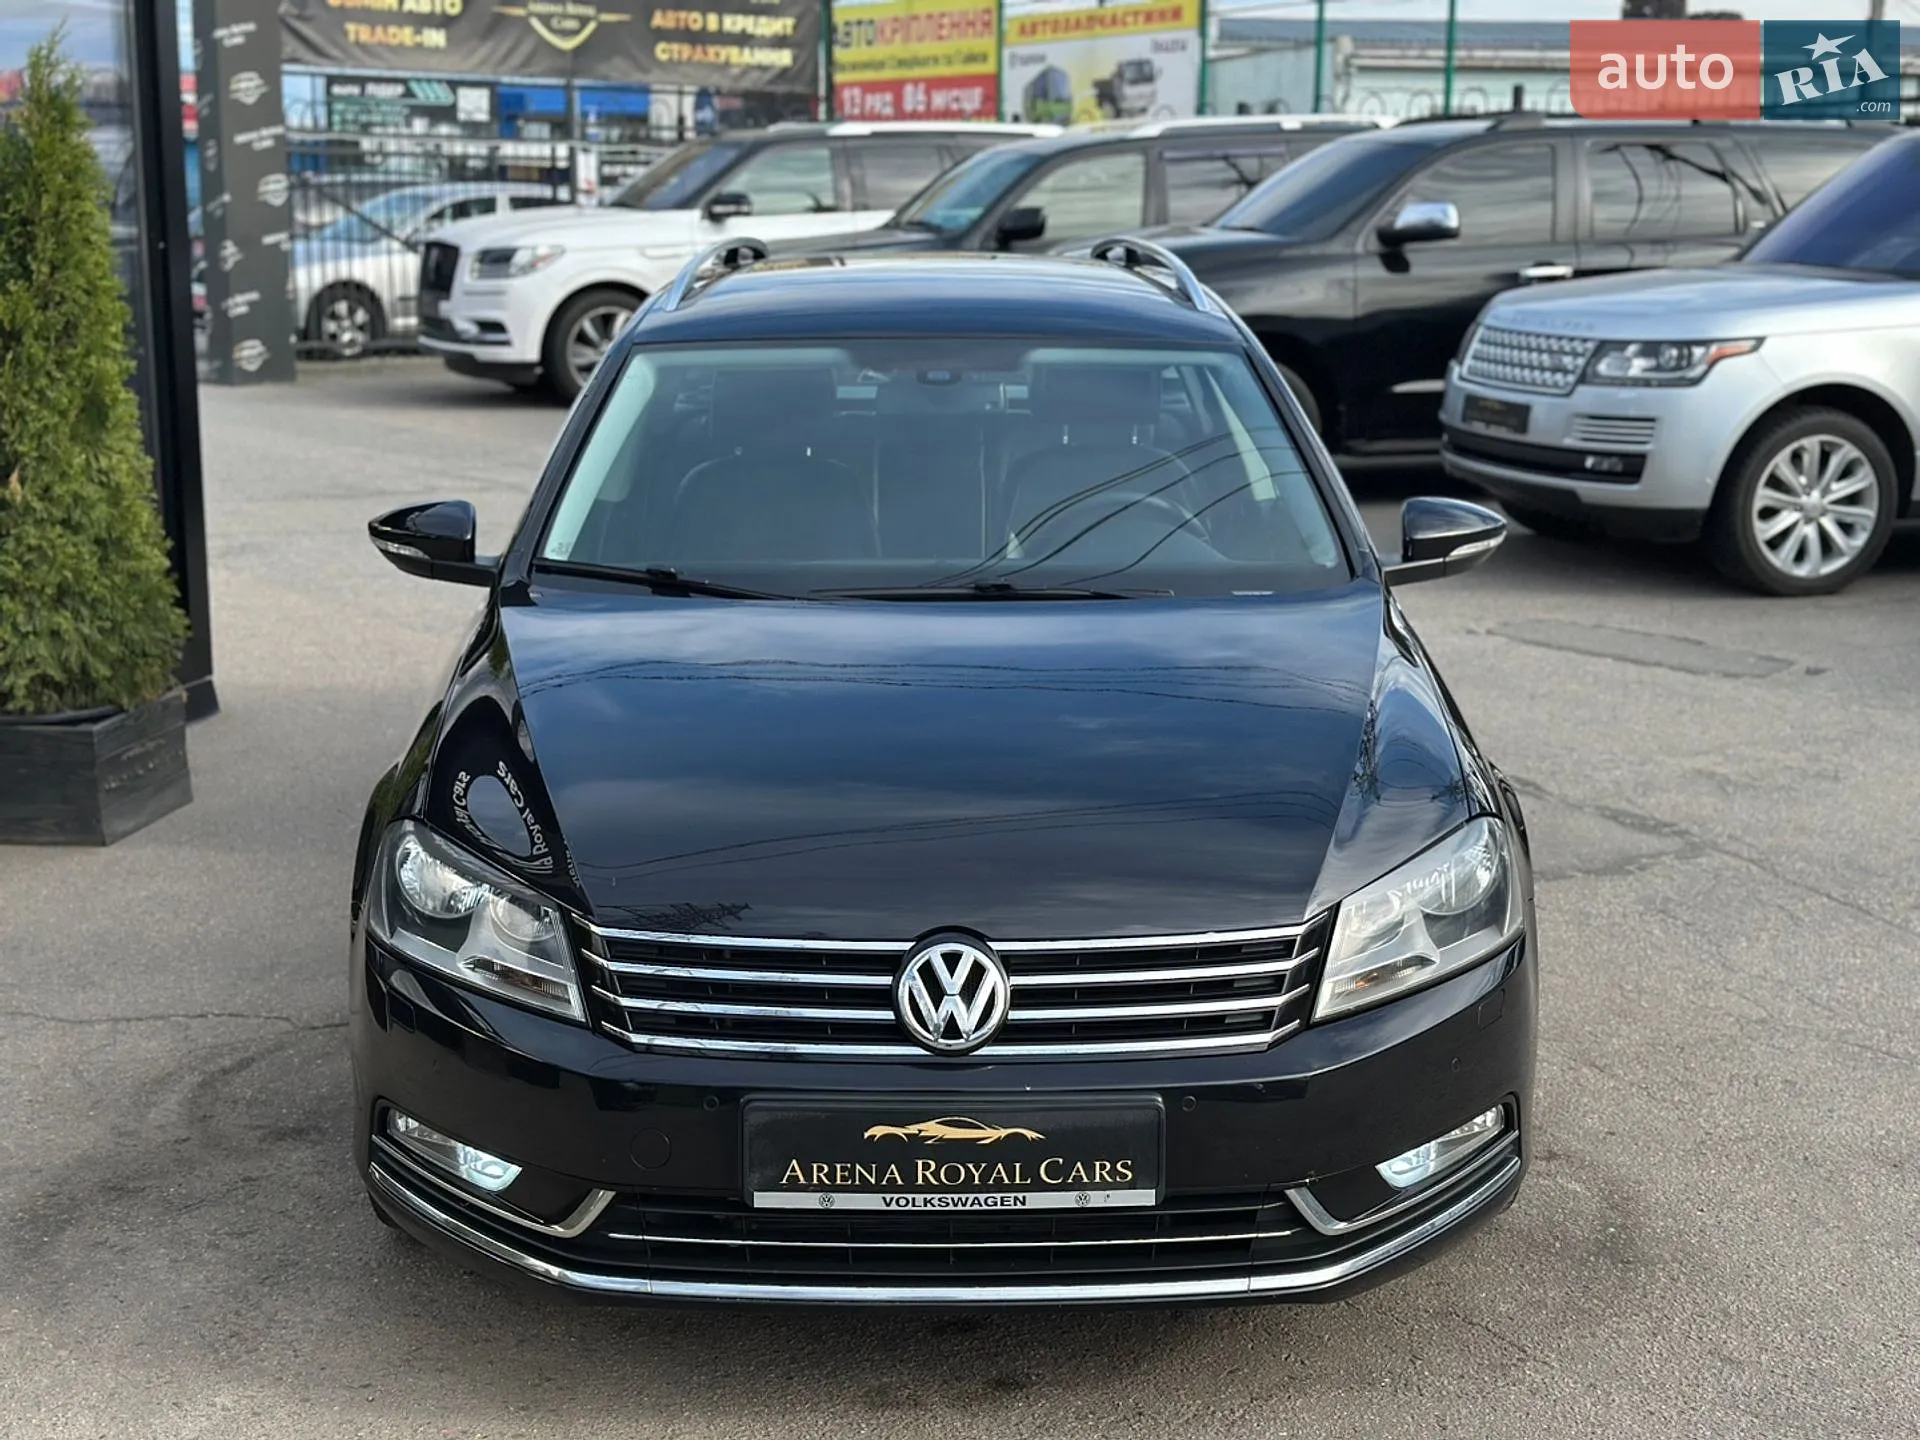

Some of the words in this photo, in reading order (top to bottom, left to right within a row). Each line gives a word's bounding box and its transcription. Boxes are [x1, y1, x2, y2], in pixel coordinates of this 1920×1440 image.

[344, 21, 447, 48] TRADE-IN
[651, 8, 703, 31] АВТО
[706, 12, 719, 32] В
[722, 13, 796, 37] КРЕДИТ
[655, 41, 793, 67] СТРАХУВАННЯ
[780, 1158, 903, 1185] ARENA
[914, 1157, 1031, 1185] ROYAL
[1039, 1157, 1133, 1184] CARS
[881, 1195, 1027, 1208] VOLKSWAGEN
